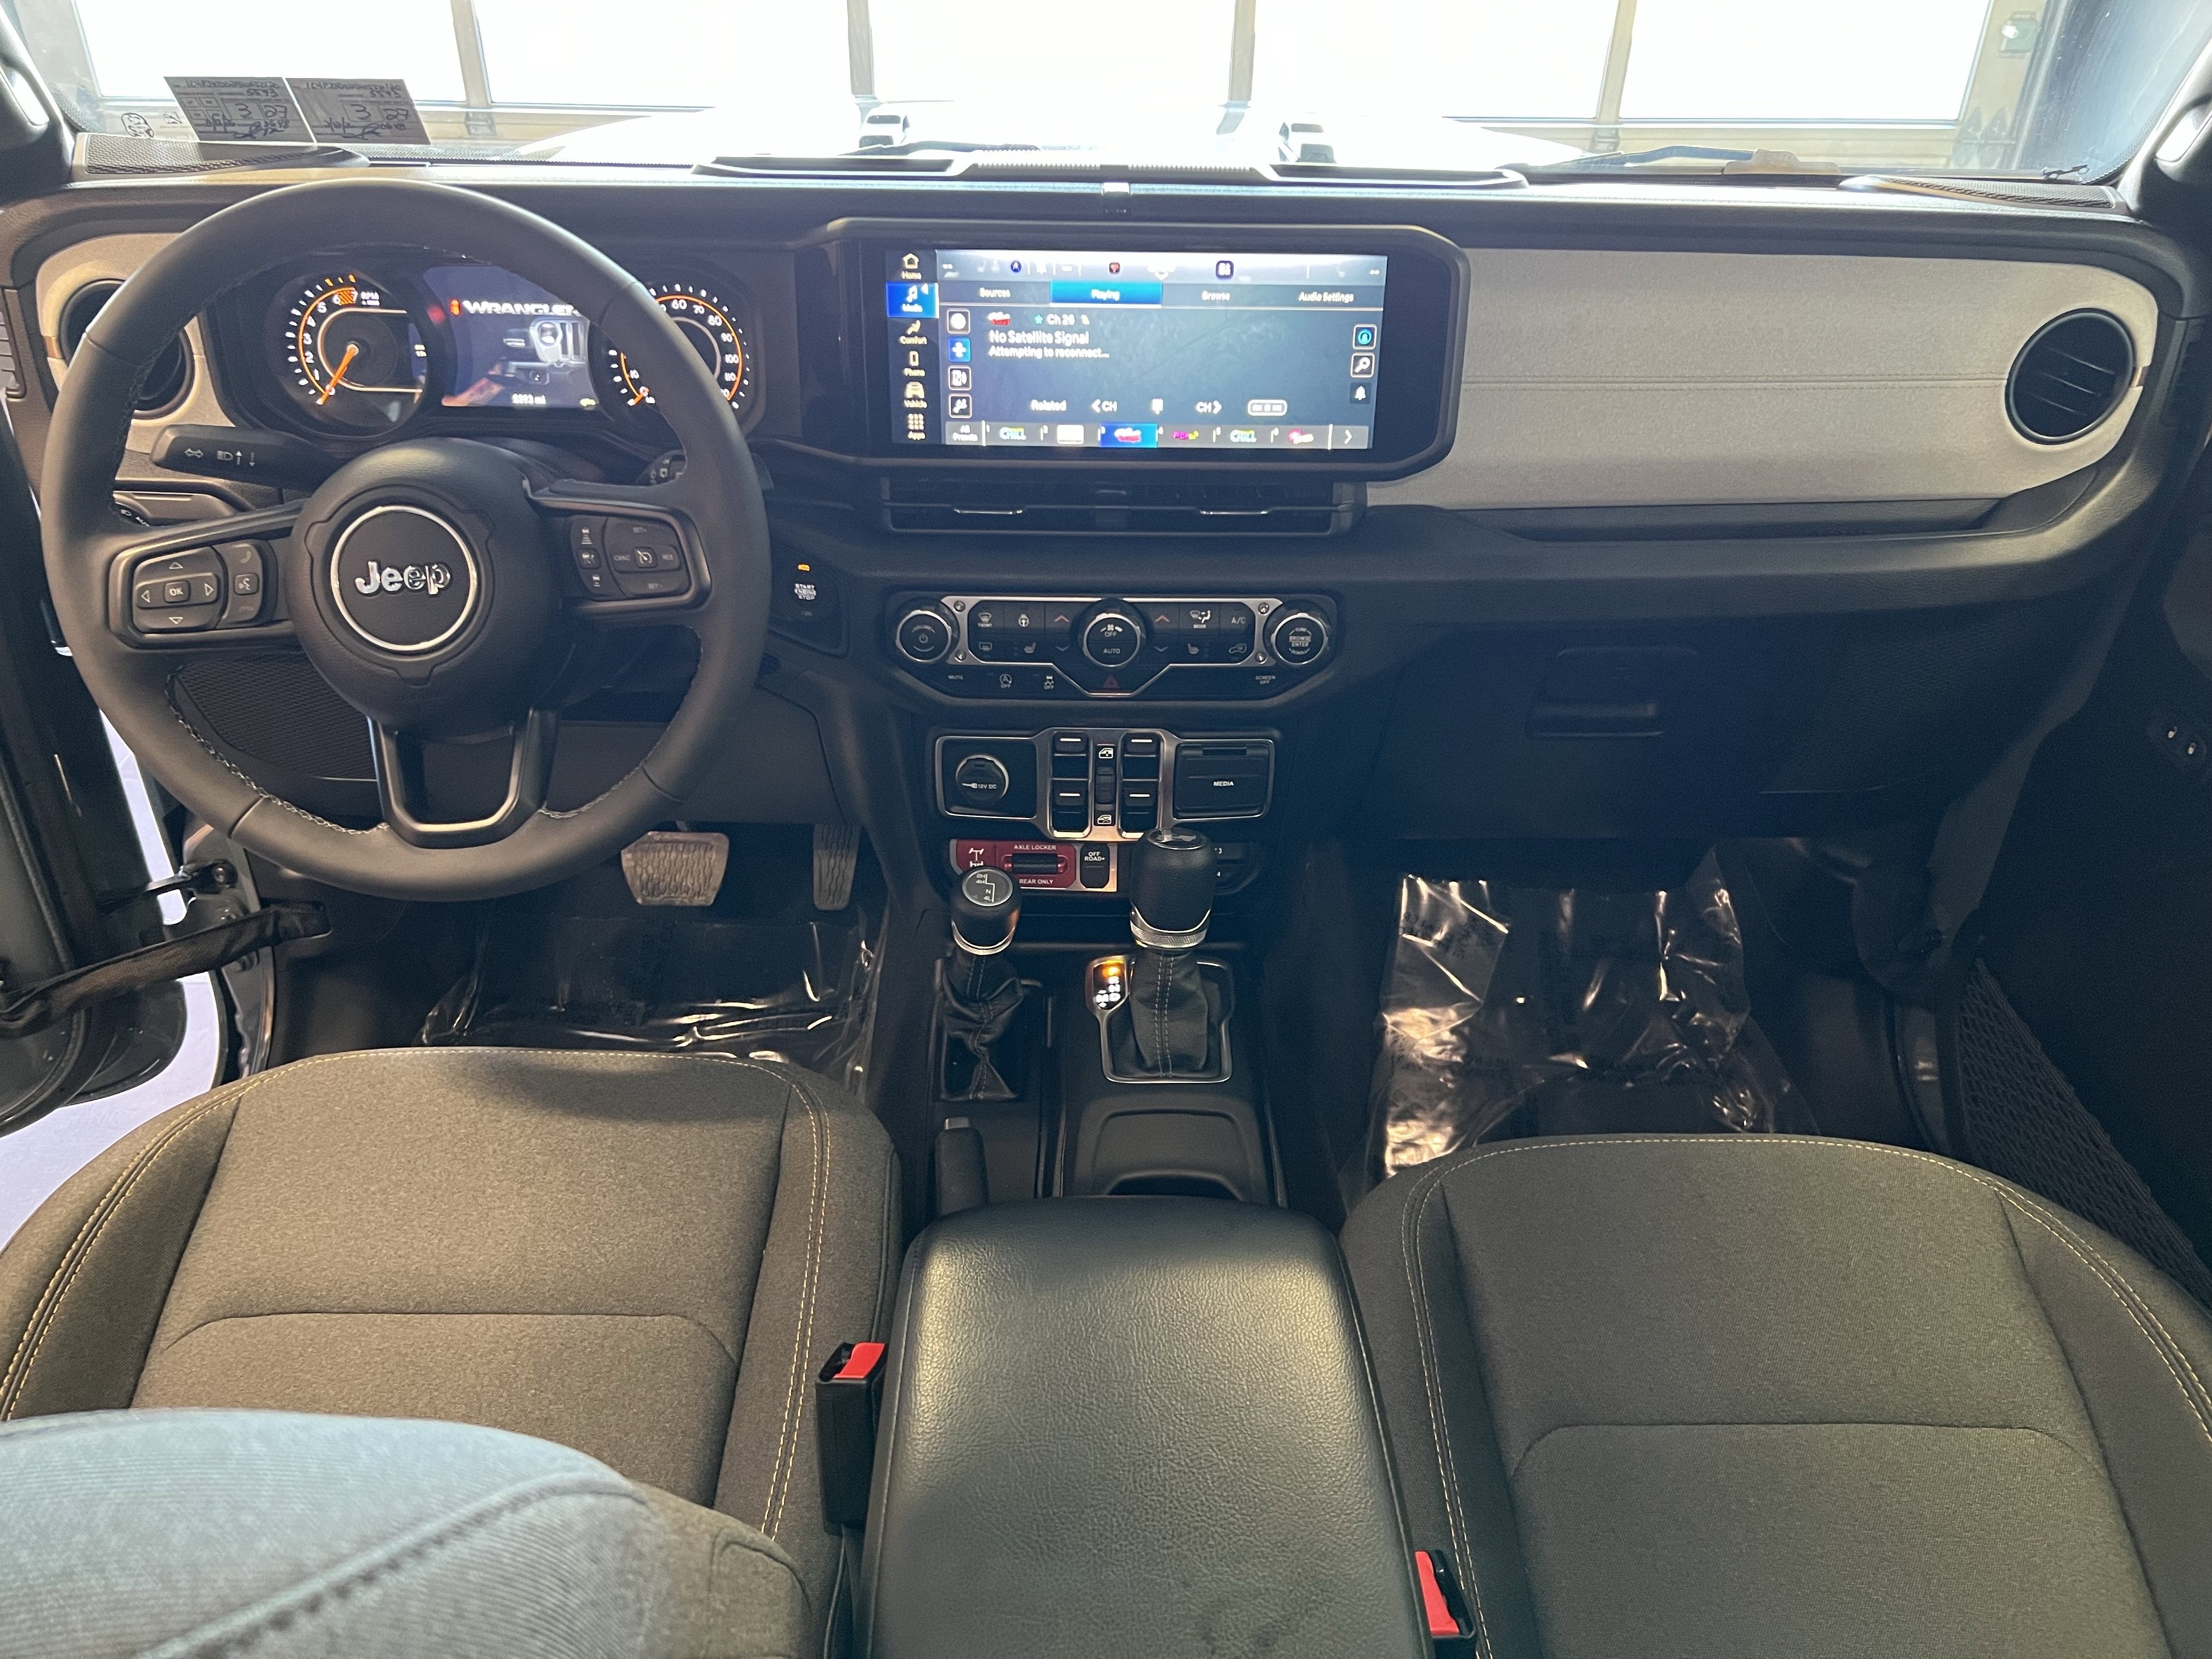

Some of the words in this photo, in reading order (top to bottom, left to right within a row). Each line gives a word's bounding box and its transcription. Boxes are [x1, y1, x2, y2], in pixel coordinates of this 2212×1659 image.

[235, 103, 252, 119] 3
[350, 104, 371, 120] 3
[901, 270, 922, 280] Home
[351, 290, 358, 303] 7
[360, 291, 380, 300] RPM
[980, 287, 1011, 298] Sources
[1091, 289, 1120, 301] Playing
[1201, 290, 1231, 301] Browse
[1299, 291, 1322, 302] Audio
[1323, 291, 1354, 303] Settings
[332, 294, 342, 306] 6
[672, 299, 687, 310] 60
[317, 301, 327, 313] 5
[693, 304, 705, 315] 70
[307, 315, 316, 328] 4
[708, 314, 723, 326] 80
[1047, 313, 1061, 325] Ch
[303, 333, 312, 345] 3
[721, 332, 733, 343] 90
[900, 336, 927, 345] Comfort
[990, 330, 1007, 344] No
[1007, 329, 1054, 345] Satellite
[1054, 330, 1090, 347] Signal
[305, 352, 314, 363] 2
[989, 345, 1042, 359] Attempting
[1043, 346, 1054, 357] to
[725, 354, 739, 364] 100
[630, 369, 640, 379] 10
[724, 372, 736, 382] 110
[1030, 400, 1067, 411] Related
[1102, 400, 1118, 412] CH
[1196, 402, 1212, 413] CH
[355, 561, 451, 595] Jeep
[169, 587, 183, 596] OK
[794, 588, 817, 596] ENGINE
[1231, 616, 1246, 625] A/C
